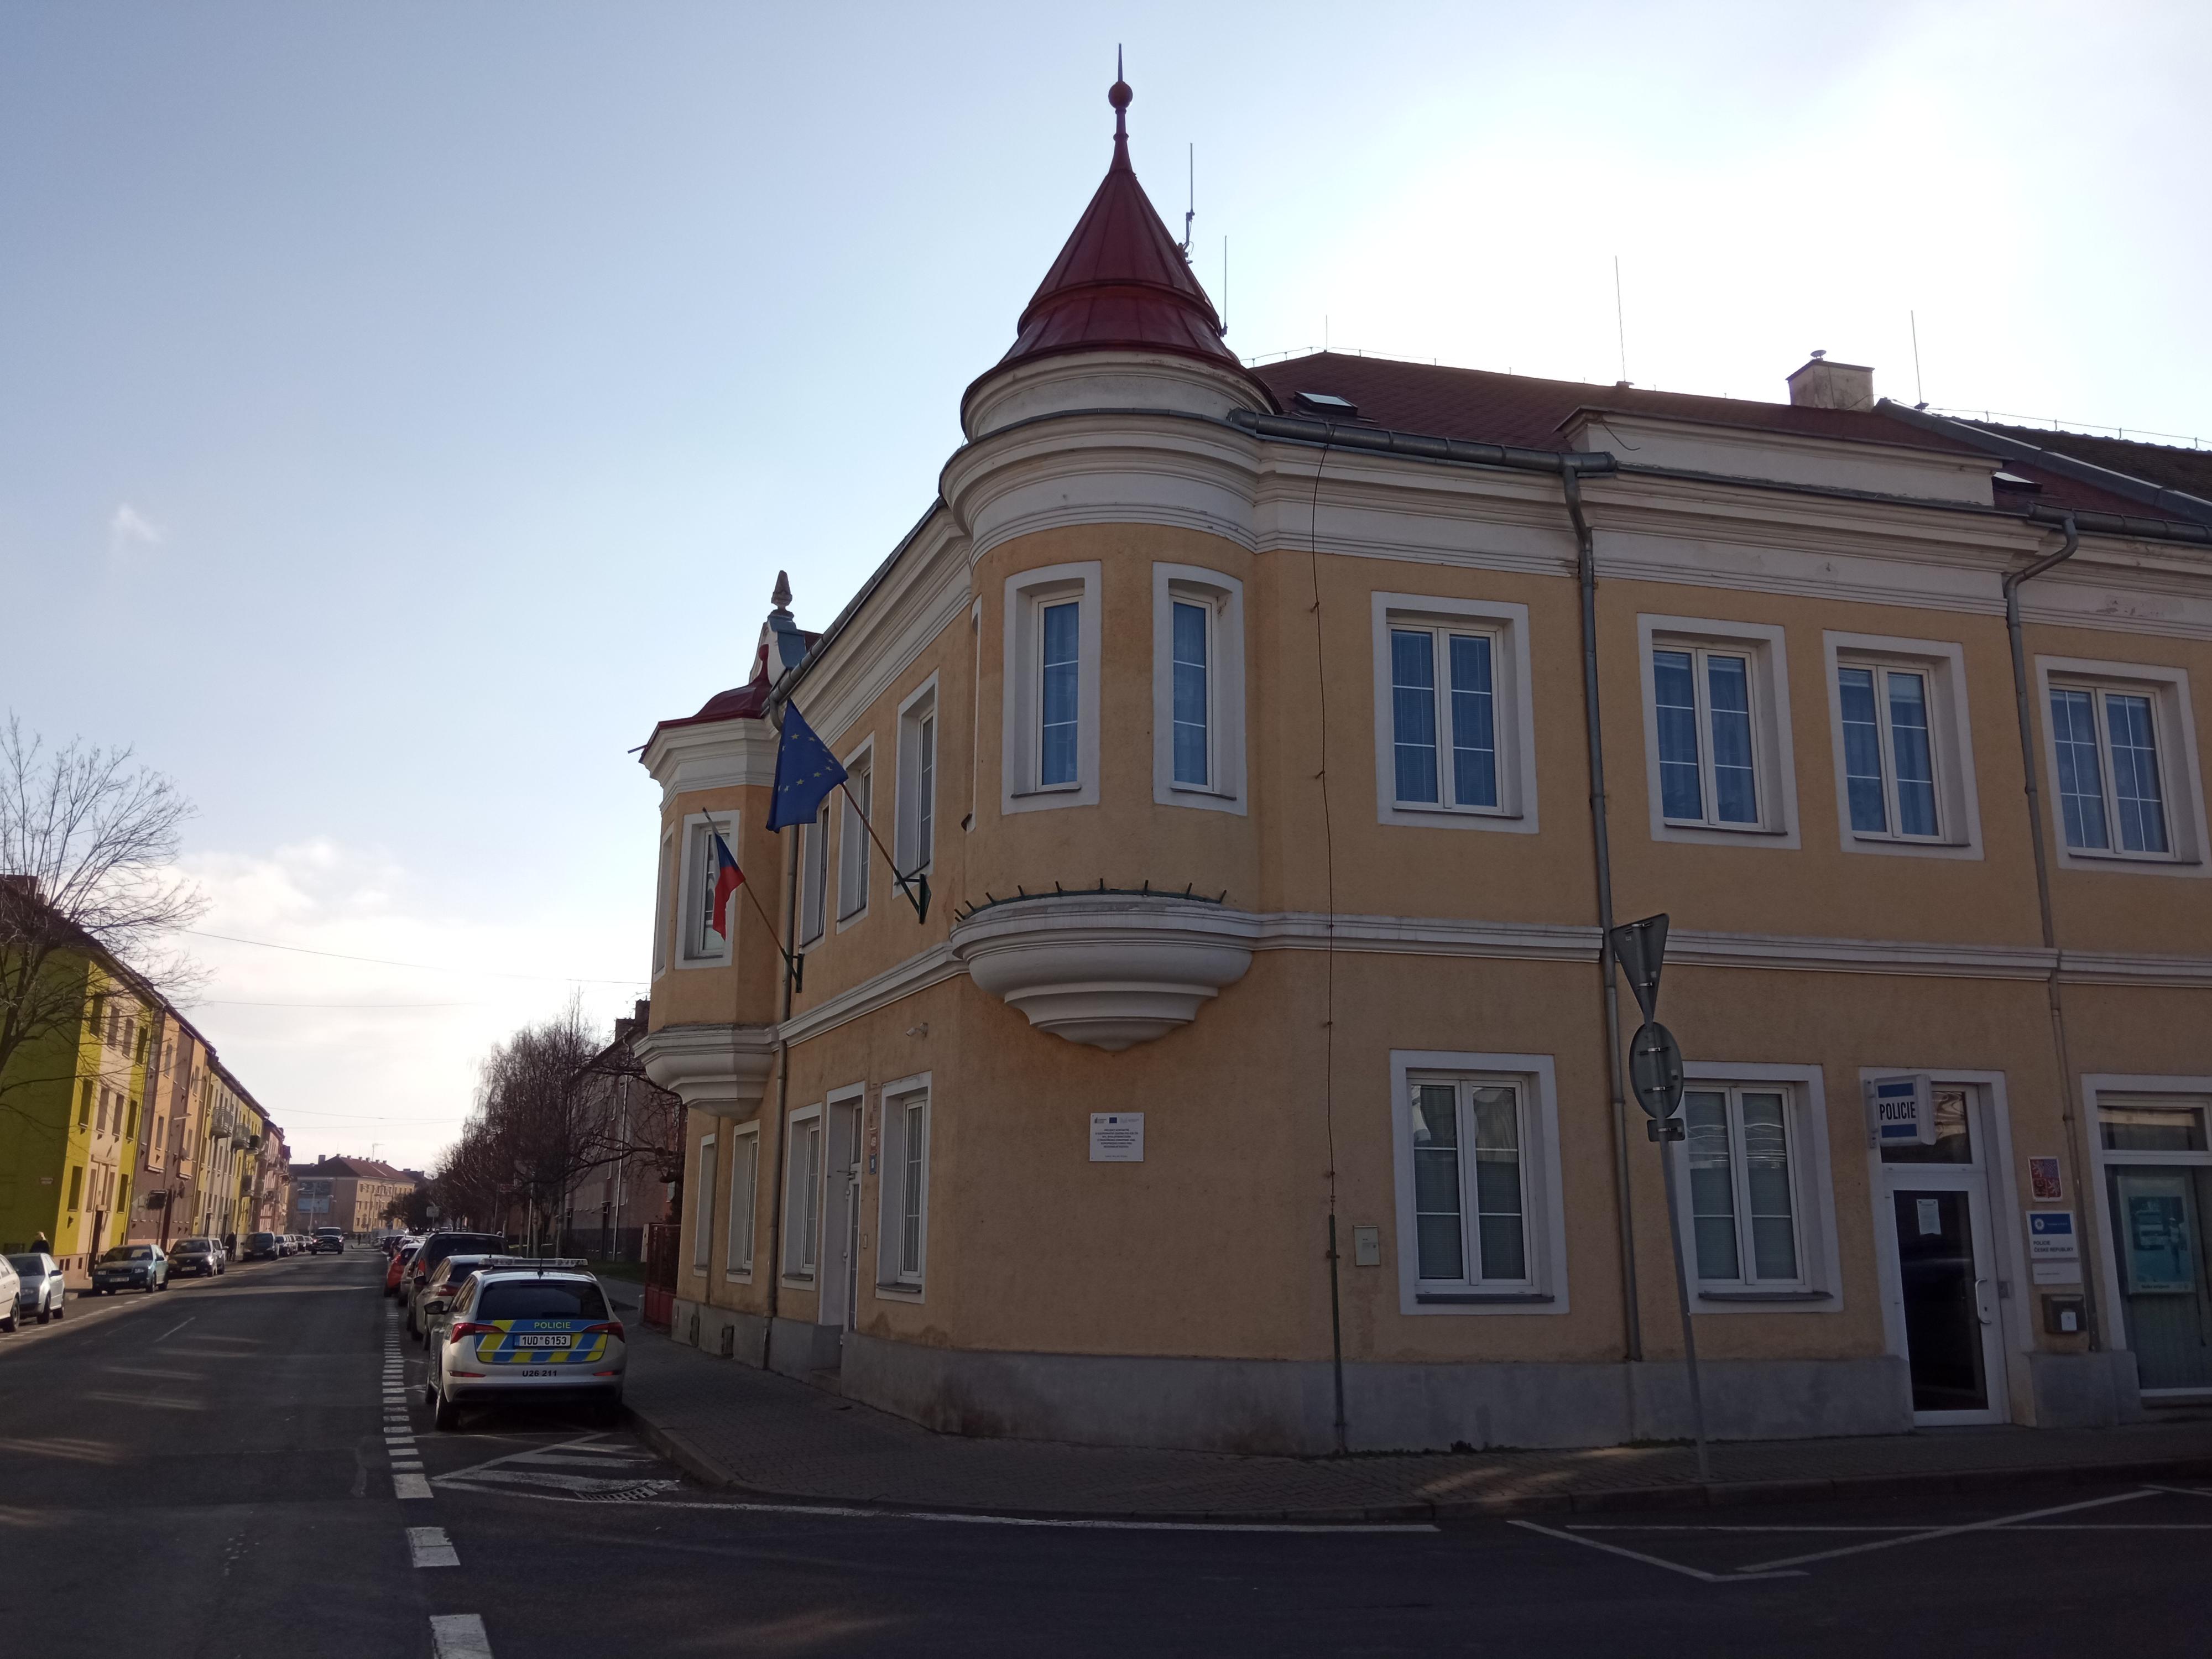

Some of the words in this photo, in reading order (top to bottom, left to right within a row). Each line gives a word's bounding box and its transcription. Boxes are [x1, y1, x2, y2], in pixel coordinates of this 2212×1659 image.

[1879, 1101, 1916, 1120] POLICIE
[522, 1336, 538, 1345] 1UD
[544, 1336, 567, 1345] 6153
